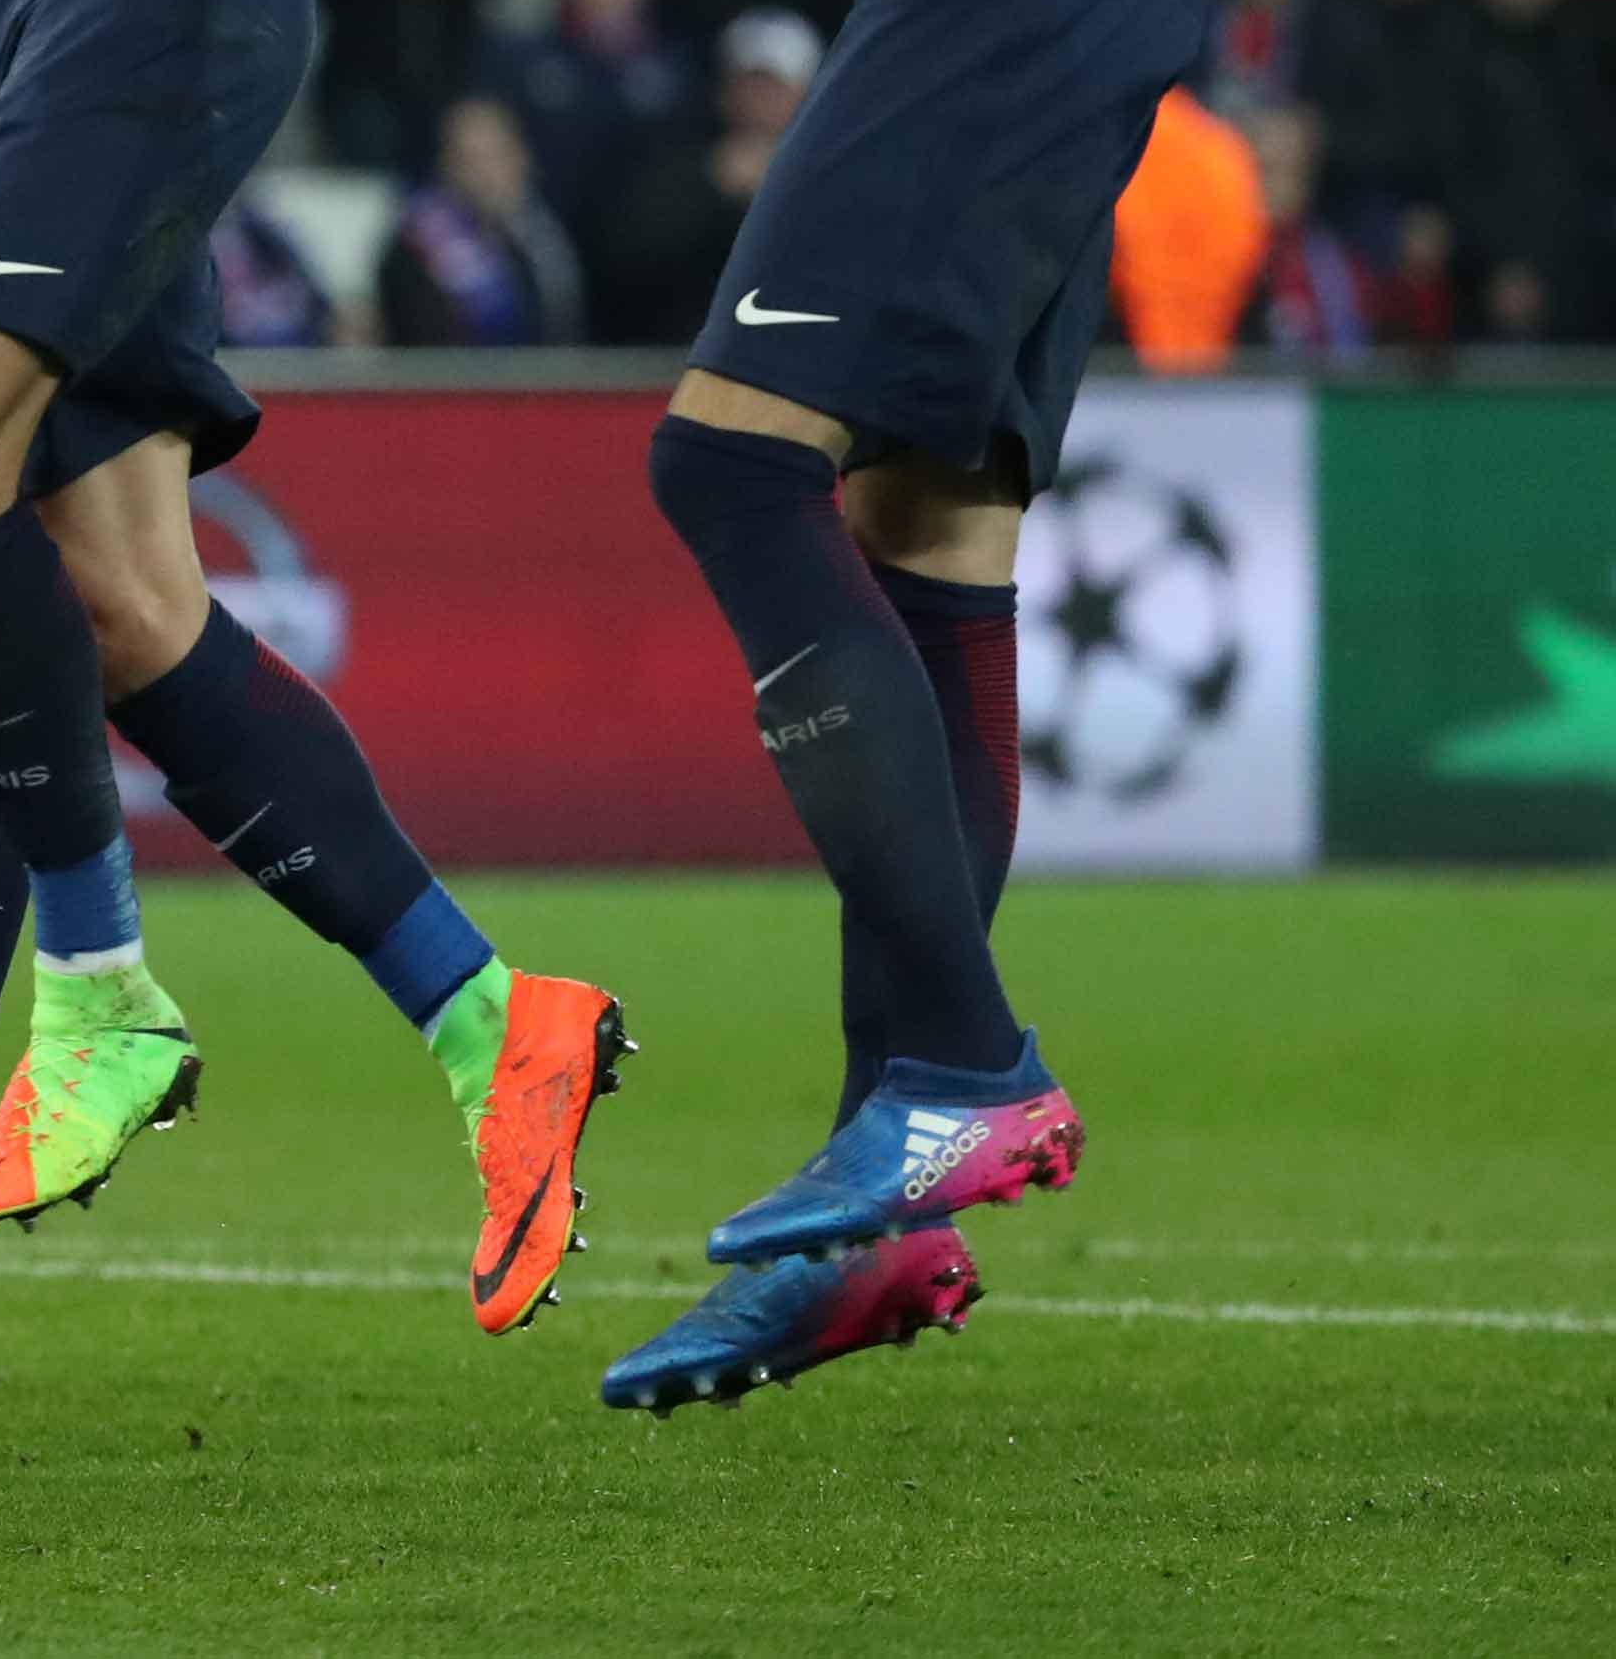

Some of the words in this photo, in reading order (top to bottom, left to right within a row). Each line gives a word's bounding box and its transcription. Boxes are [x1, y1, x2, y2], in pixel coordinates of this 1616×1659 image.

[758, 705, 850, 752] ARIS
[258, 845, 317, 887] RIS
[904, 1120, 991, 1201] adidas
